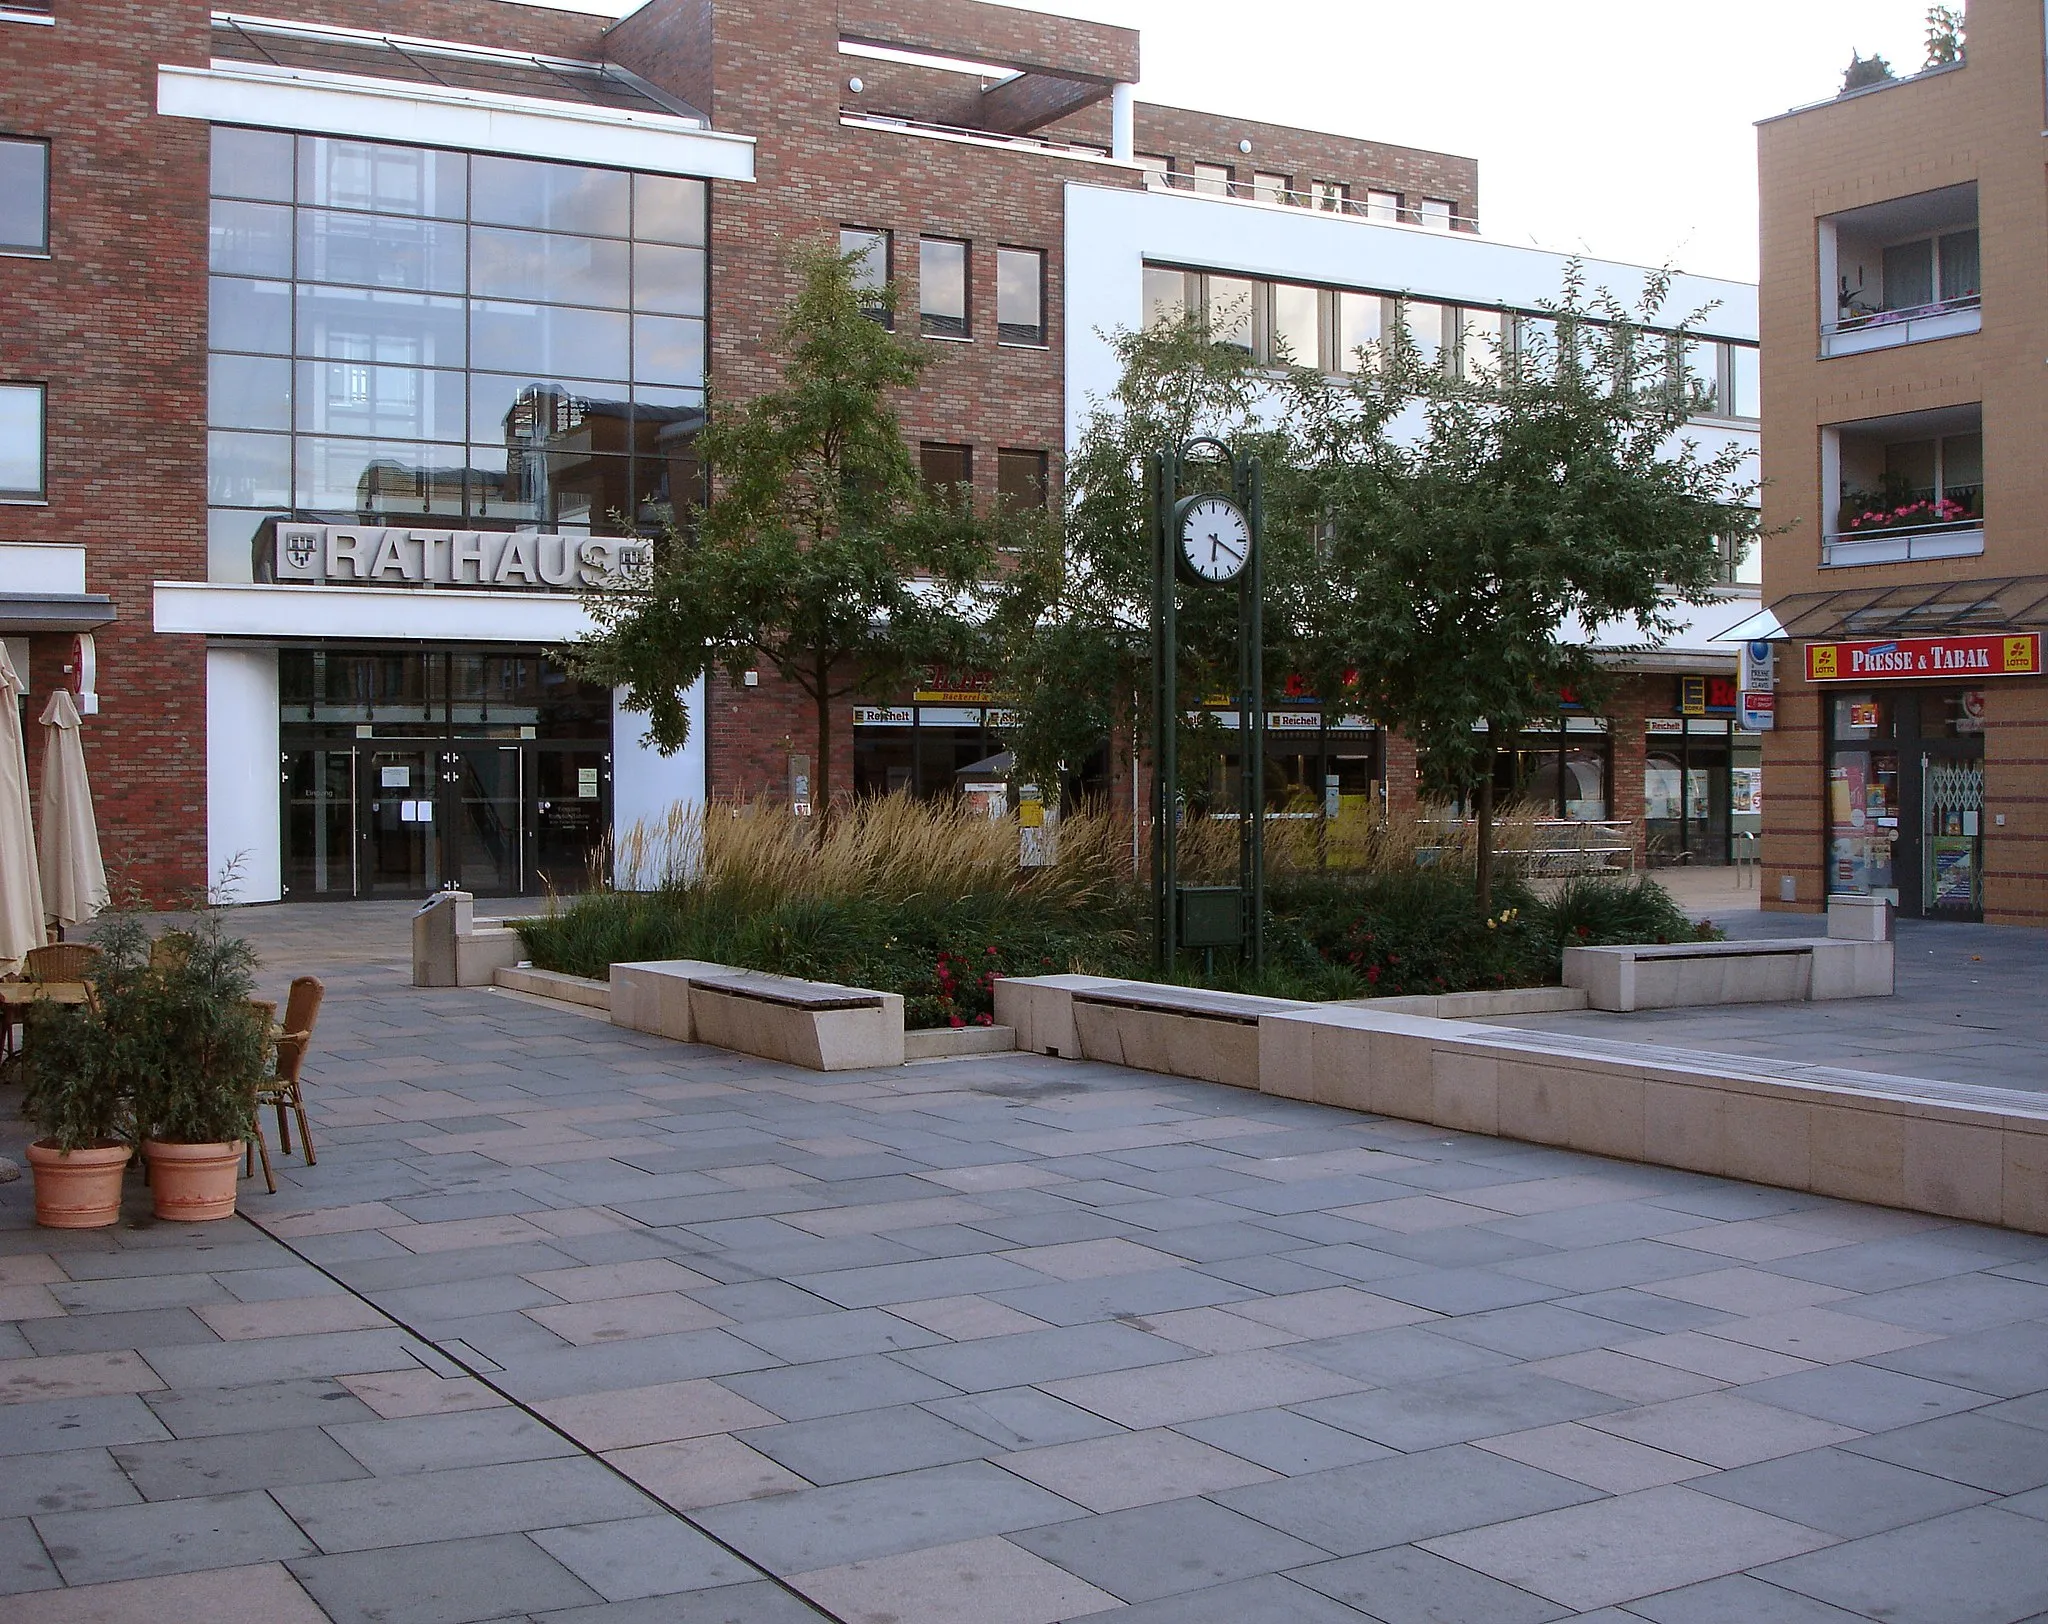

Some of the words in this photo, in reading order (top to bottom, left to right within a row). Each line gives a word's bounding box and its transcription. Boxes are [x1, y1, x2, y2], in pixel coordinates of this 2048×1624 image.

[325, 527, 612, 586] RATHAUS
[1852, 649, 1913, 672] PRESSE
[1918, 655, 1927, 669] &
[1931, 646, 1989, 669] TABAK
[2006, 659, 2029, 667] LOTTO
[867, 711, 910, 721] Rehelt
[1282, 716, 1318, 725] Reichelt
[1651, 721, 1681, 730] Reichelt
